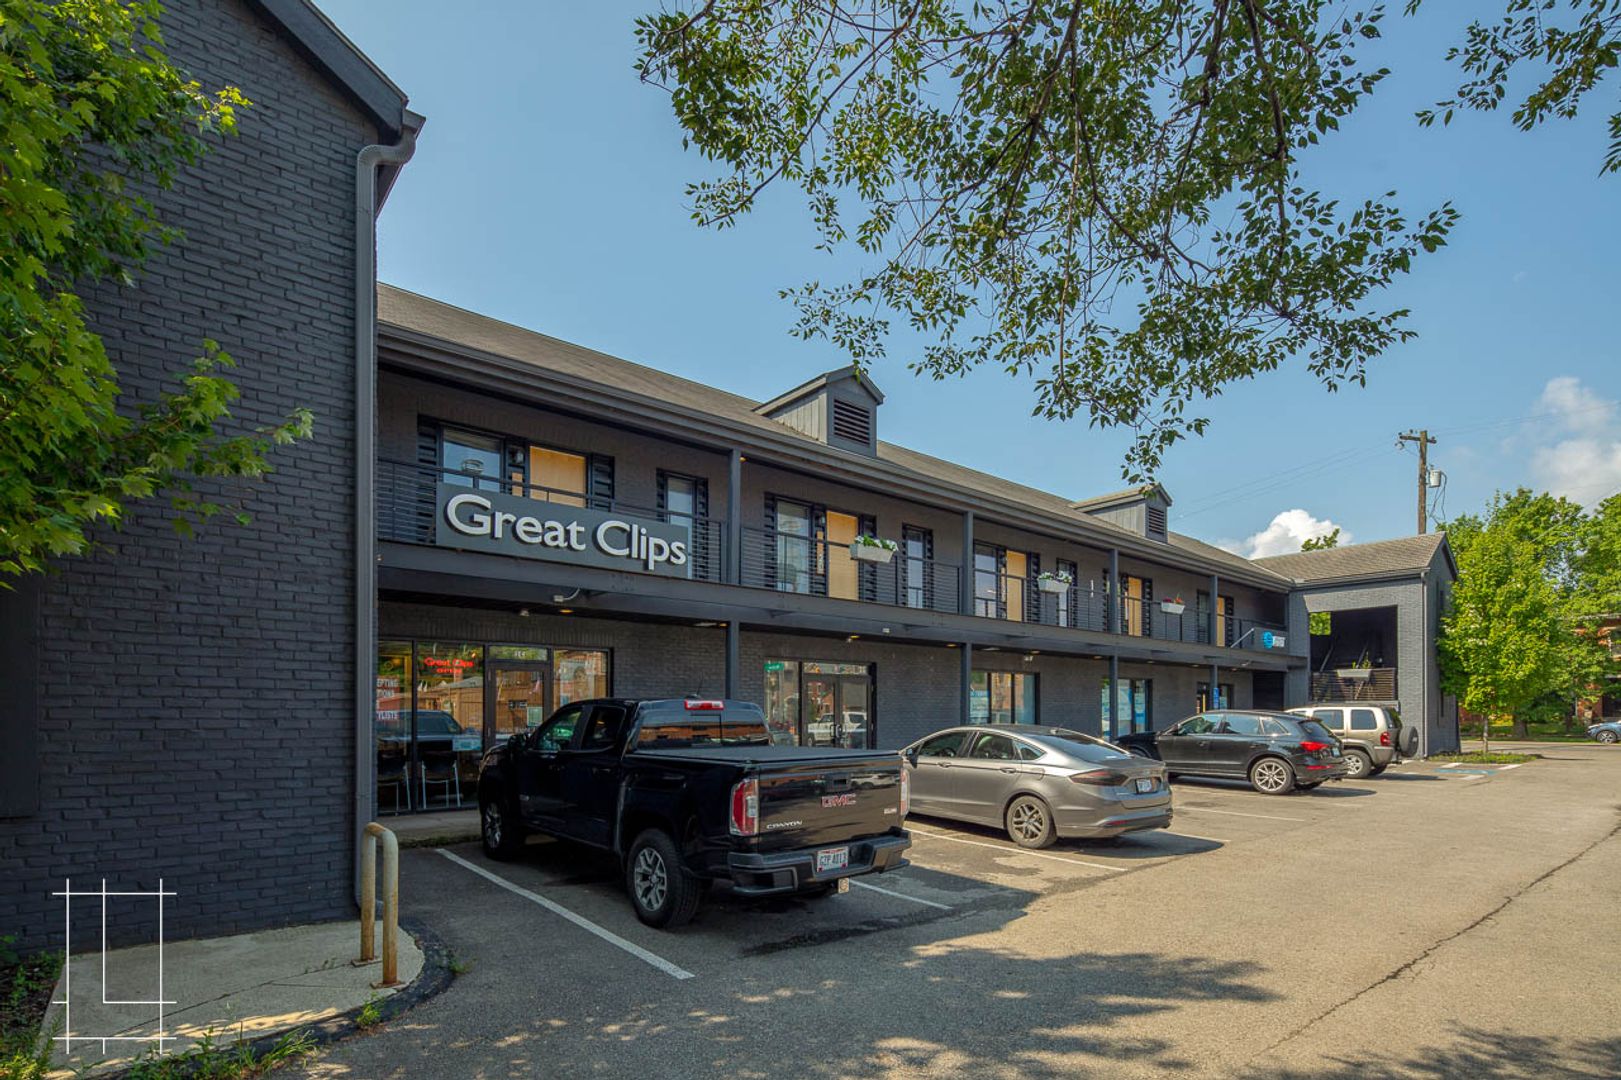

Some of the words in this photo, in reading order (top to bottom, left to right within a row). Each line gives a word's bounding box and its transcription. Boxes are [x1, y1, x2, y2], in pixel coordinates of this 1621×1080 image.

[446, 493, 586, 551] Great
[597, 520, 687, 570] Clips
[424, 657, 450, 666] Great
[376, 678, 399, 687] EPTING
[821, 793, 857, 807] GMC
[766, 821, 803, 829] CANYON
